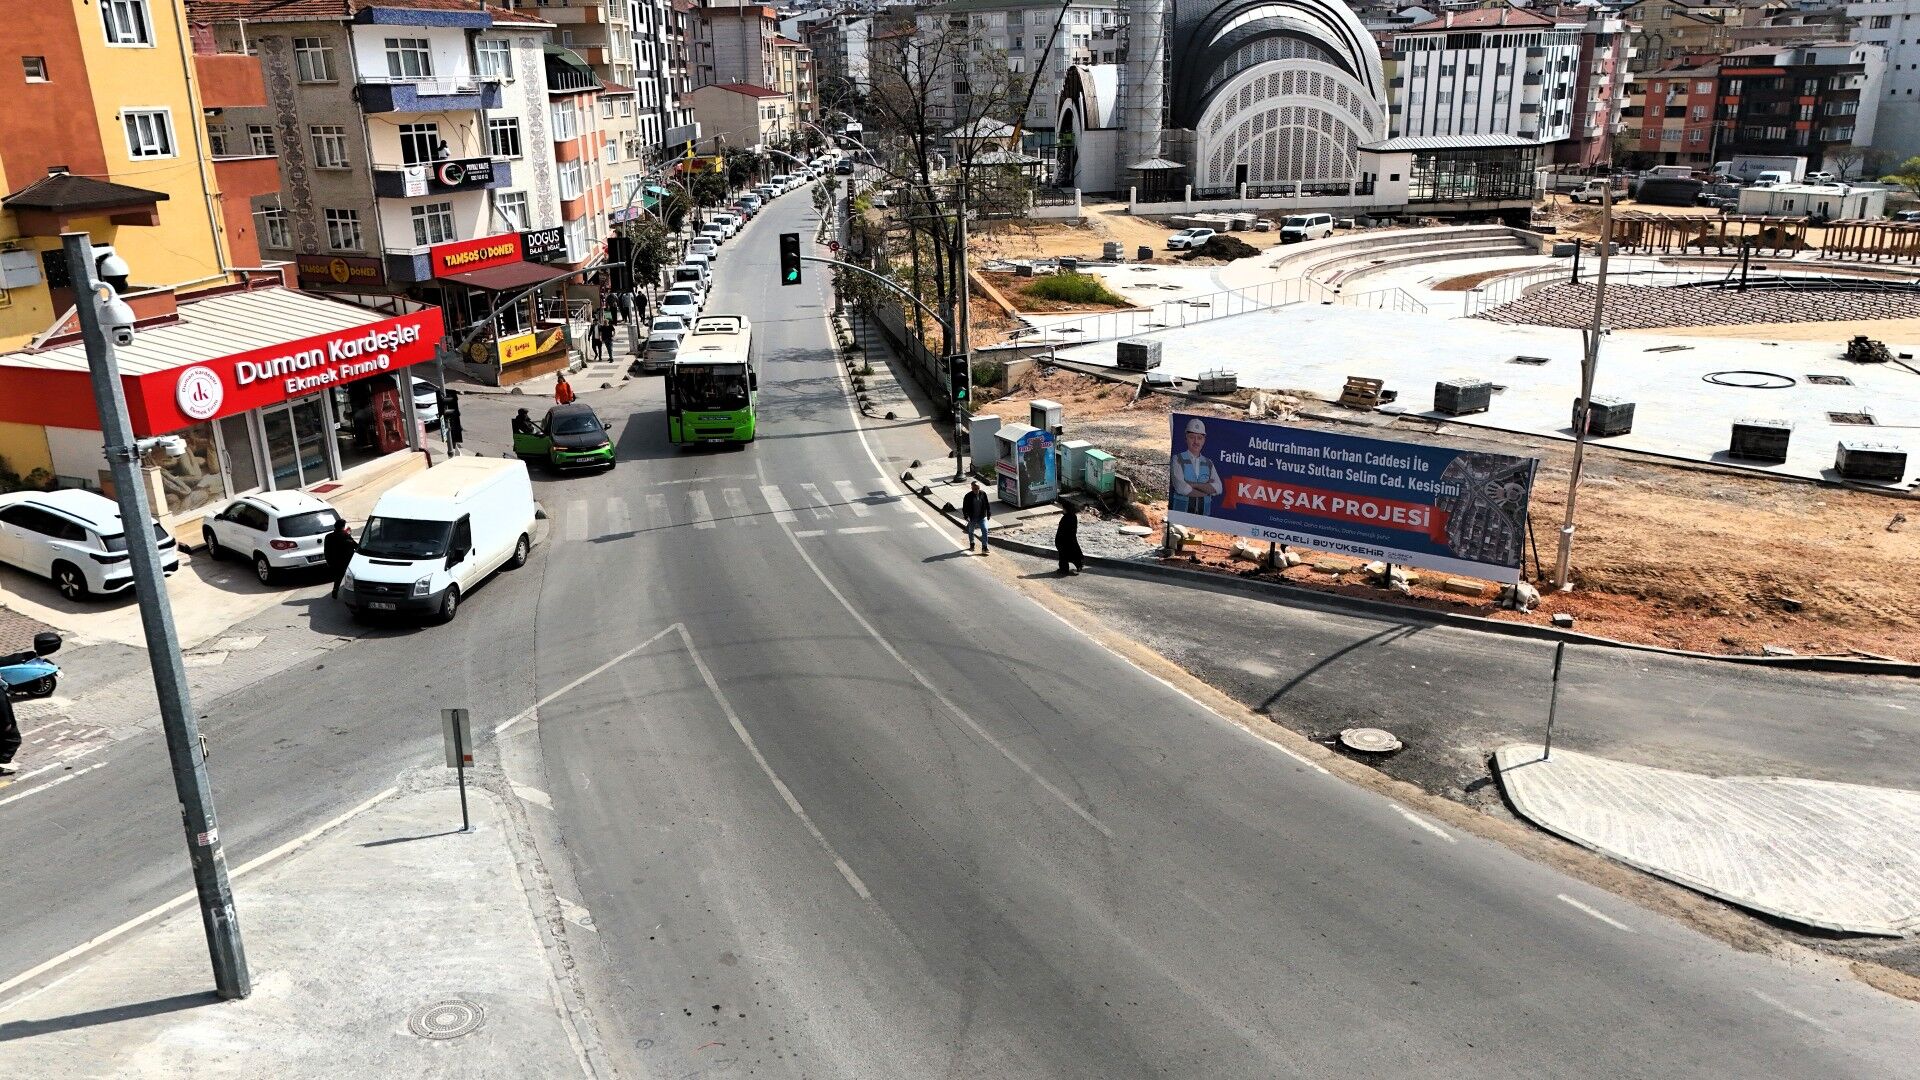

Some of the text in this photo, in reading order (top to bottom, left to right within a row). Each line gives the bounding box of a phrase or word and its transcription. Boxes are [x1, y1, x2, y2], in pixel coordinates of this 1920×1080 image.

[300, 264, 329, 274] TAMSOS
[445, 250, 480, 267] TAMSOS
[235, 324, 421, 386] Duman Kardeşler
[182, 373, 194, 393] Duman
[193, 382, 209, 401] dk
[286, 368, 339, 393] Ekmek
[340, 360, 377, 378] Fırını
[1248, 436, 1320, 458] Abdurrahman
[1322, 446, 1362, 463] Korhan
[1365, 452, 1411, 470] Caddesi
[1220, 450, 1246, 466] Fatih
[1247, 454, 1267, 468] Cad
[1276, 458, 1306, 474] Yavuz
[1308, 463, 1343, 480] Sultan
[1346, 468, 1377, 484] Selim
[1380, 473, 1405, 488] Cad.
[1408, 476, 1460, 496] Kesişimi
[1238, 482, 1430, 527] KAVŞAK PROJESİ
